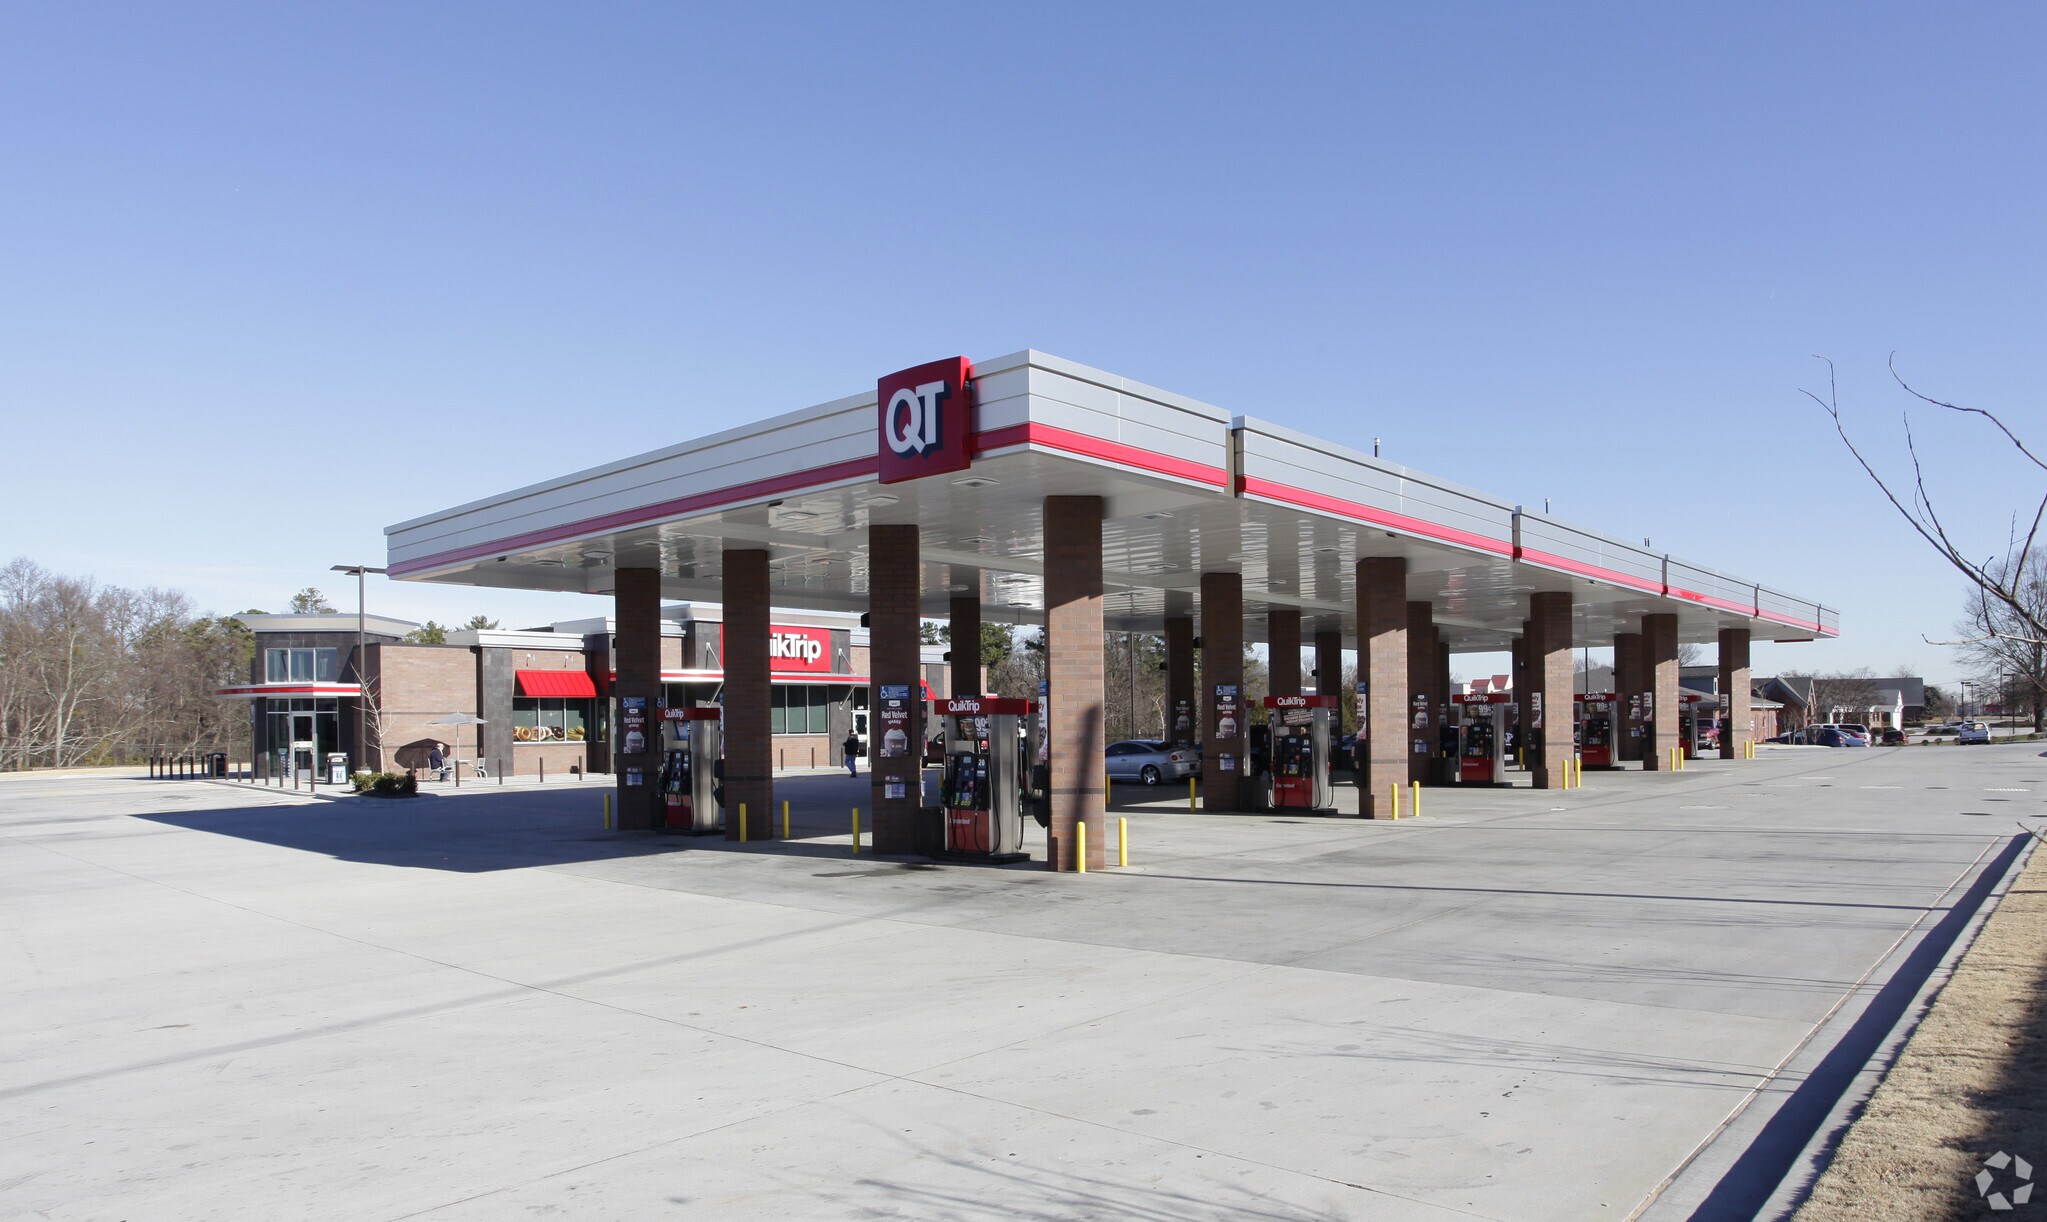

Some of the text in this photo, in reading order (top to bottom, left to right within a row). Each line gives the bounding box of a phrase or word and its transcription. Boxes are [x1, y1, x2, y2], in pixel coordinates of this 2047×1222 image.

[886, 380, 945, 454] QT
[770, 633, 822, 664] ikTrip
[948, 700, 980, 714] QuikTrip
[1277, 696, 1306, 707] QuikTrip
[881, 711, 908, 719] Red Velvet
[978, 758, 986, 766] 20
